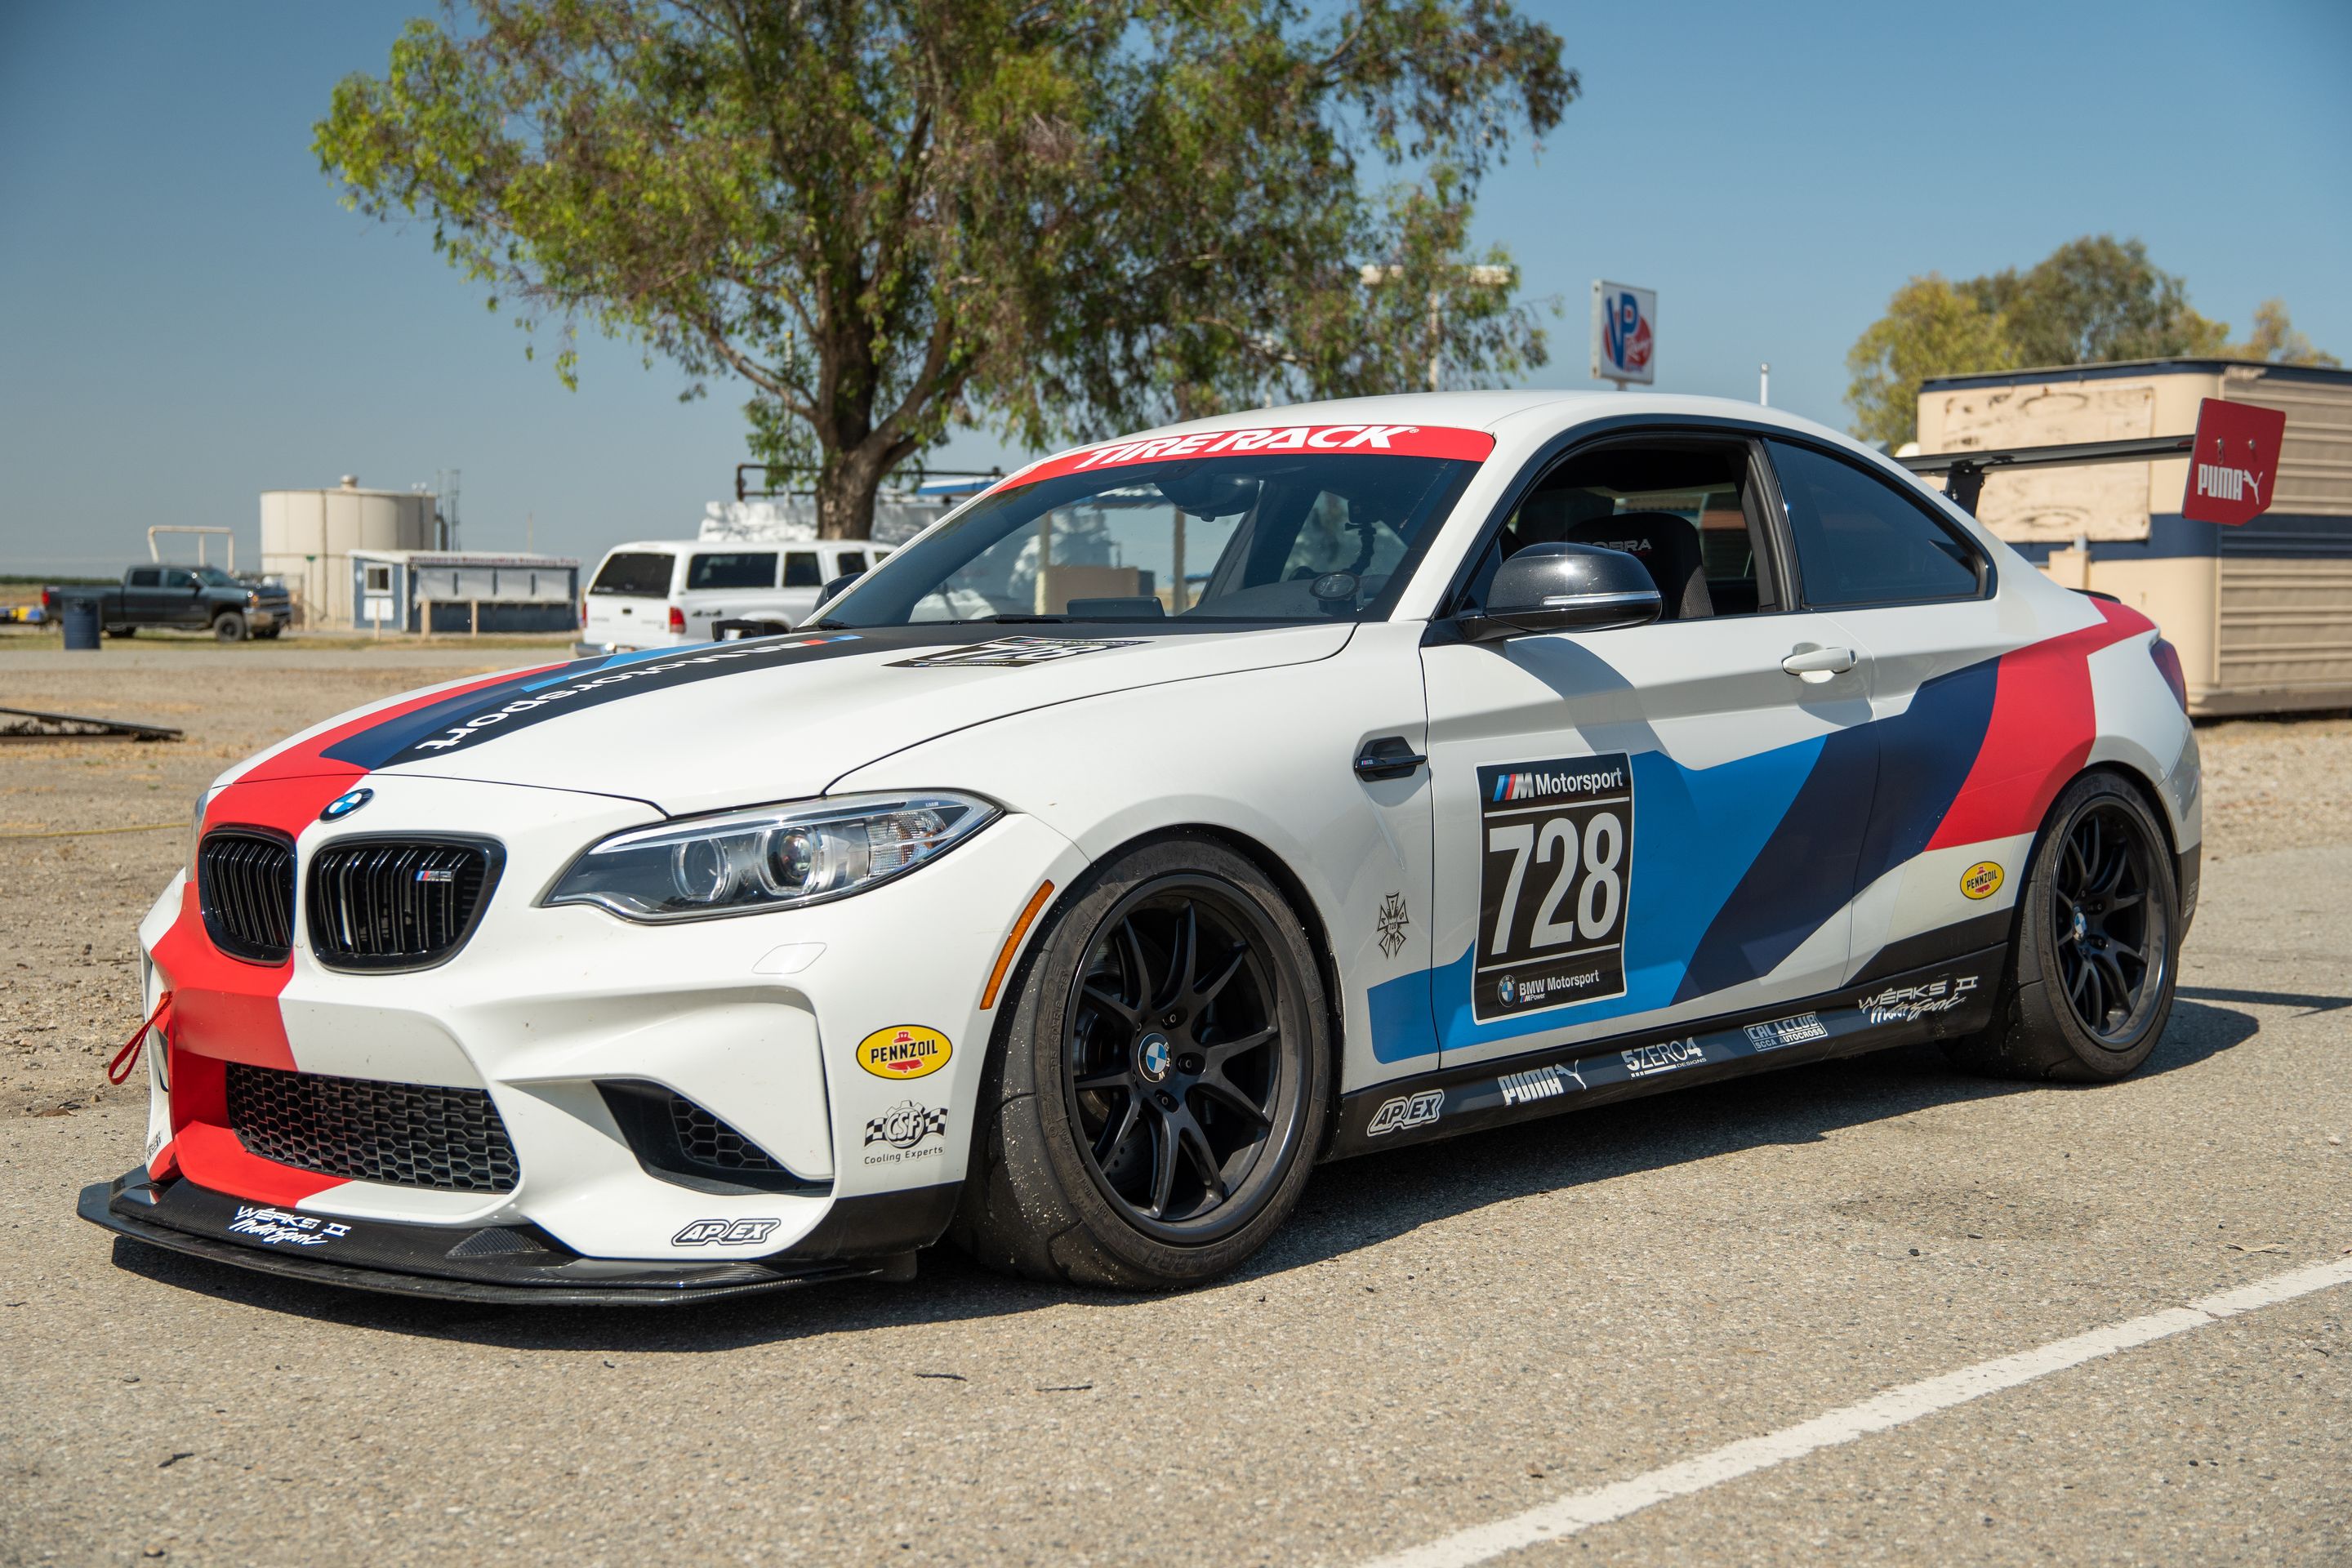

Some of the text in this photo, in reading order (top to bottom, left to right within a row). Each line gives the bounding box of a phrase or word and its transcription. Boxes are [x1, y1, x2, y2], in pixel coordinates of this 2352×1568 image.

[1605, 292, 1638, 371] VP
[1074, 425, 1413, 470] TIRE RACK
[2197, 463, 2243, 501] PUMA
[1579, 539, 1652, 551] OBRA
[928, 643, 1107, 661] 728
[415, 653, 749, 751] Motorsport
[1535, 768, 1624, 796] Motorsport
[1489, 812, 1623, 956] 728
[1966, 869, 1998, 891] PENNZOIL
[1519, 969, 1600, 996] BMW Motorsport
[871, 1039, 938, 1064] PENNZOIL
[1755, 1027, 1824, 1050] SCCA AUTOCROSS
[1676, 1058, 1707, 1069] DESIGNS
[1497, 1066, 1564, 1106] PUMA
[887, 1111, 922, 1141] CSF
[864, 1146, 944, 1165] Cooling Experts
